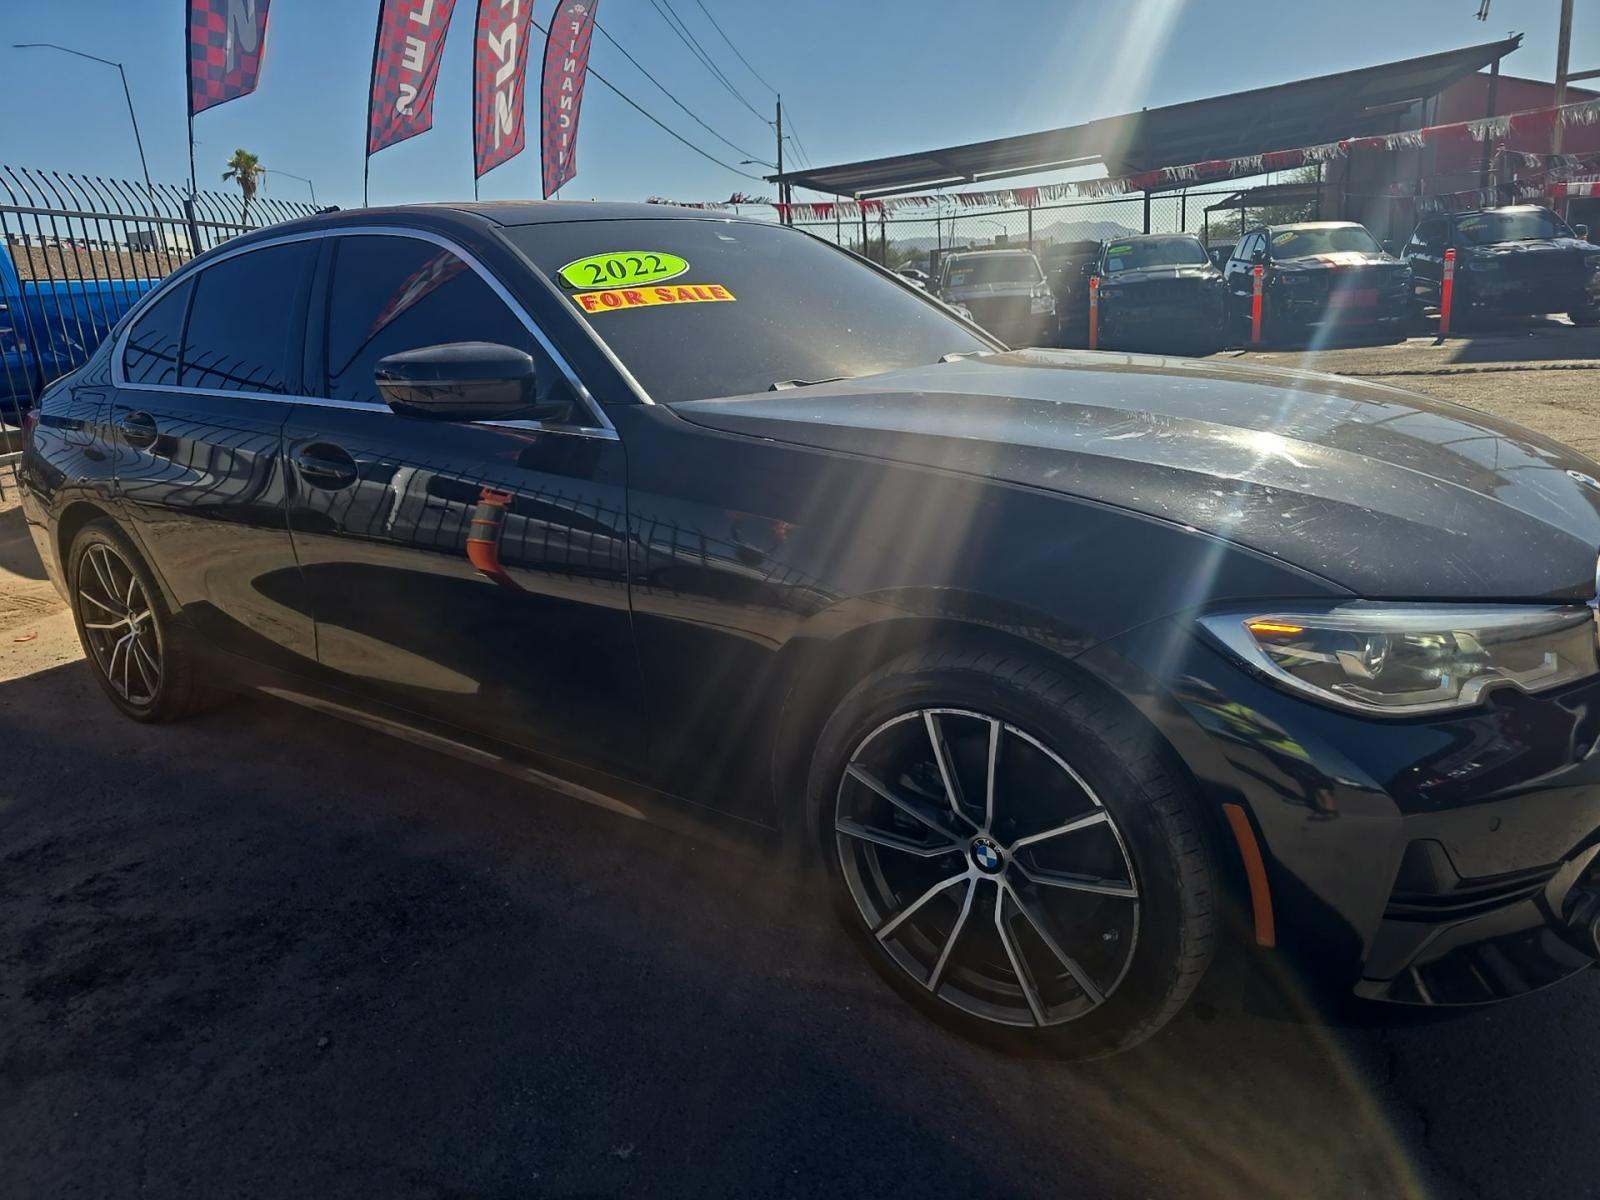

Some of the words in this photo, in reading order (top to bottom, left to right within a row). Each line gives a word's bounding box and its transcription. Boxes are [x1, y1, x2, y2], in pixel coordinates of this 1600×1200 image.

[583, 255, 667, 285] 2022
[579, 290, 648, 311] FOR
[654, 286, 730, 303] SALE
